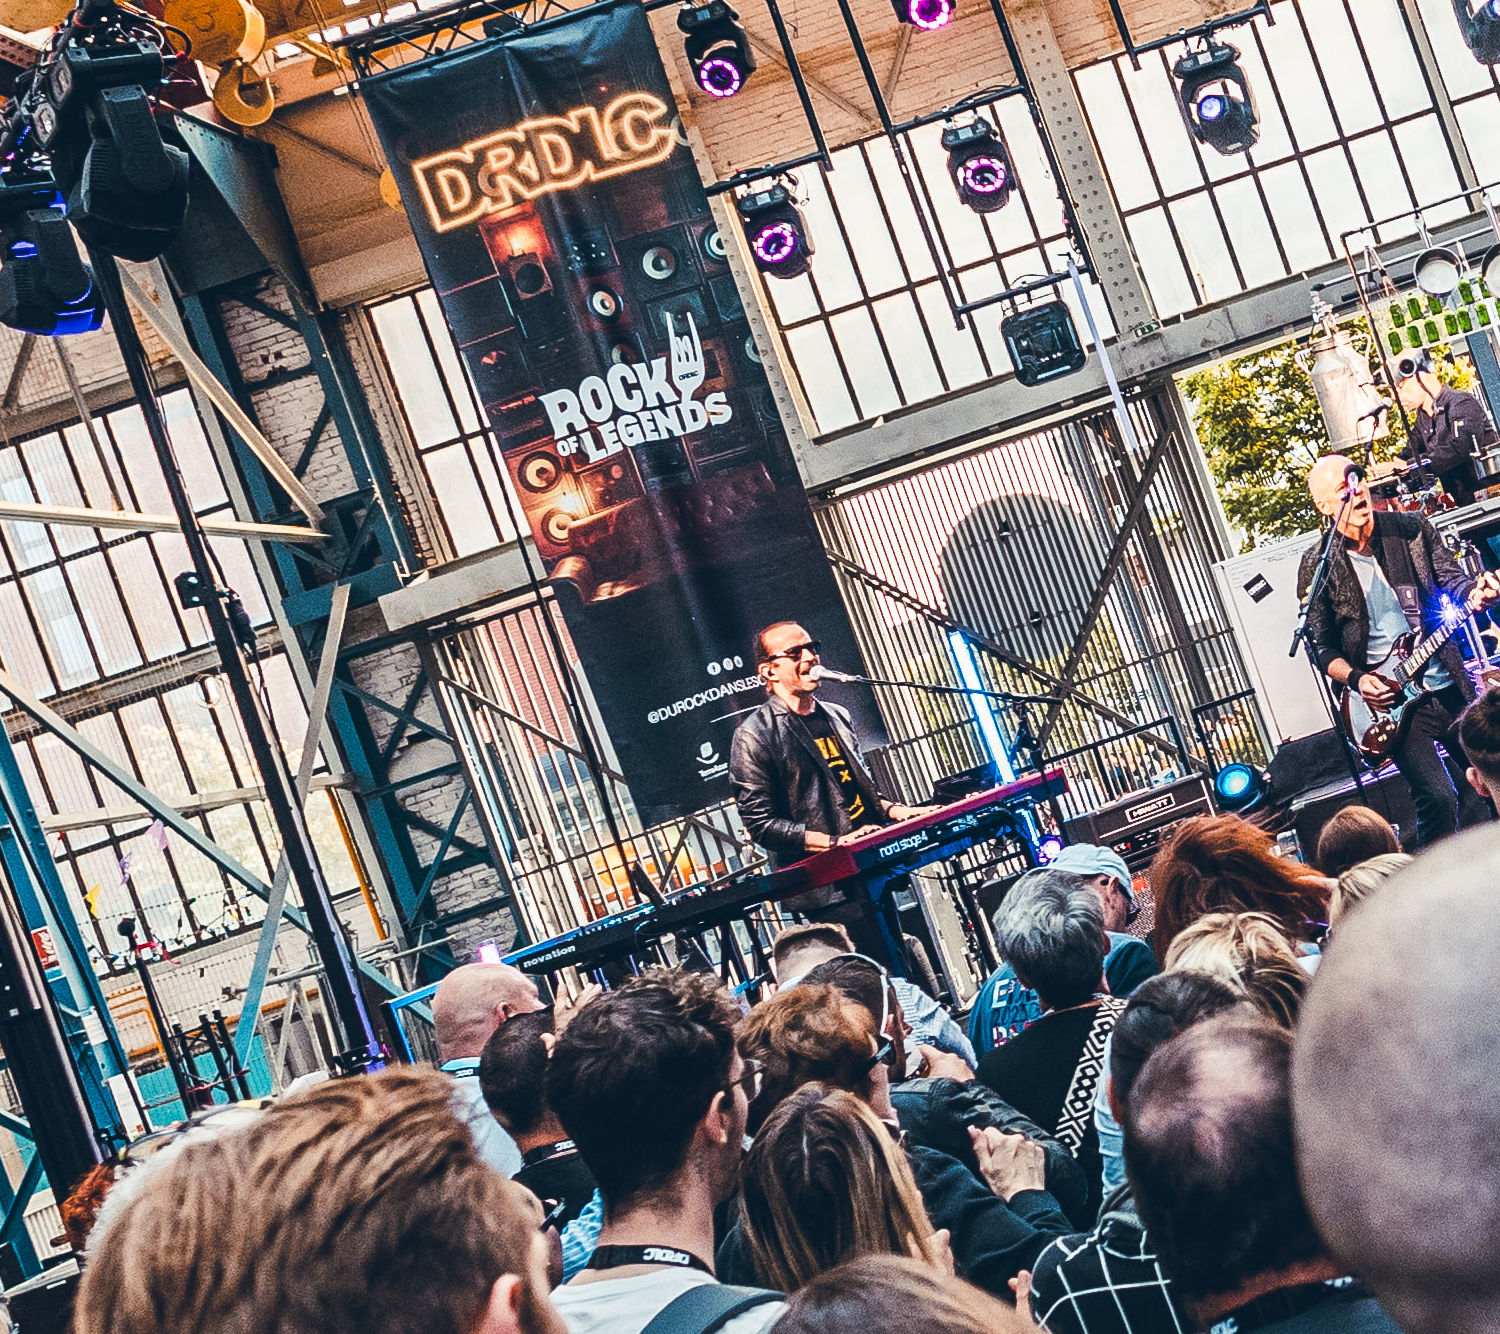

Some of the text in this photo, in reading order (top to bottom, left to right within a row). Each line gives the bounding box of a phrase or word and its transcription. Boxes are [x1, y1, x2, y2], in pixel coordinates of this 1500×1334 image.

[538, 356, 680, 440] ROCK
[556, 391, 733, 464] OF LEGENDS
[523, 945, 576, 969] novation
